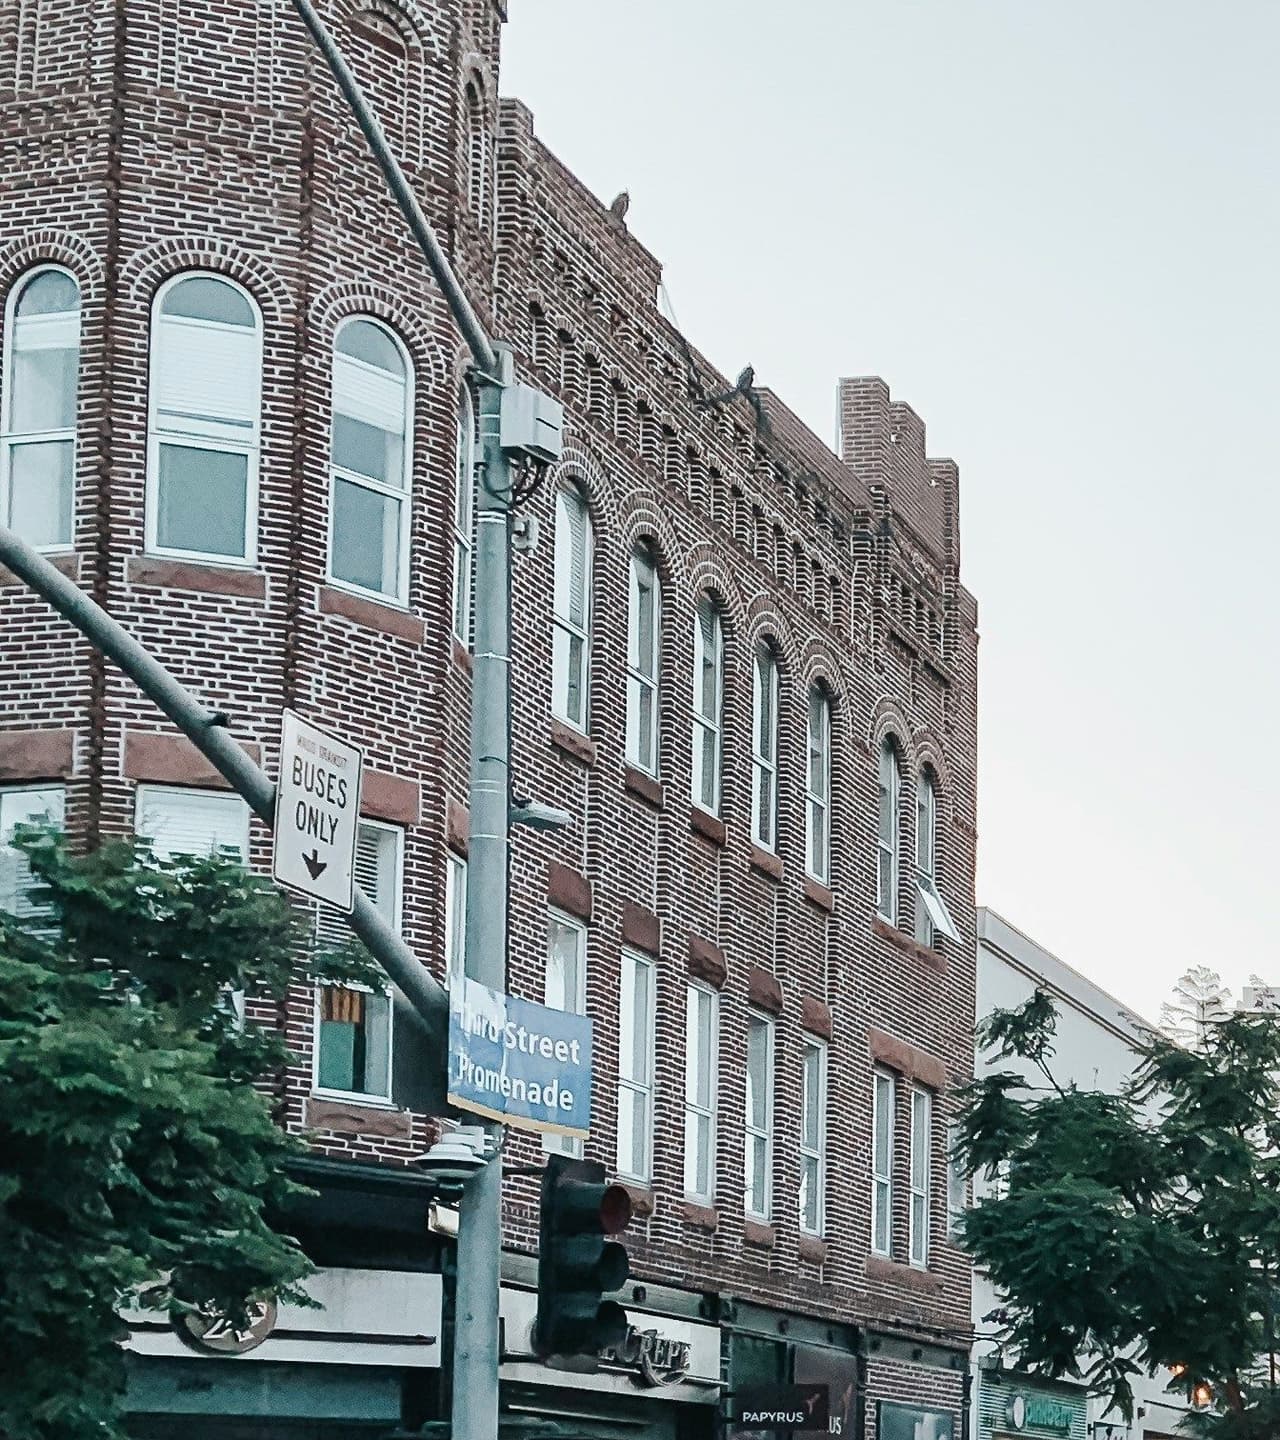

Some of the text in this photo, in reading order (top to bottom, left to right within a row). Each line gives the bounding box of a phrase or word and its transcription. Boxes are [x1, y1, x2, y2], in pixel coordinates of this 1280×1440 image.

[292, 755, 347, 809] BUSES
[296, 801, 339, 846] ONLY
[504, 1021, 580, 1065] Street
[455, 1049, 573, 1111] Promenade
[743, 1412, 804, 1423] PAPYRUS
